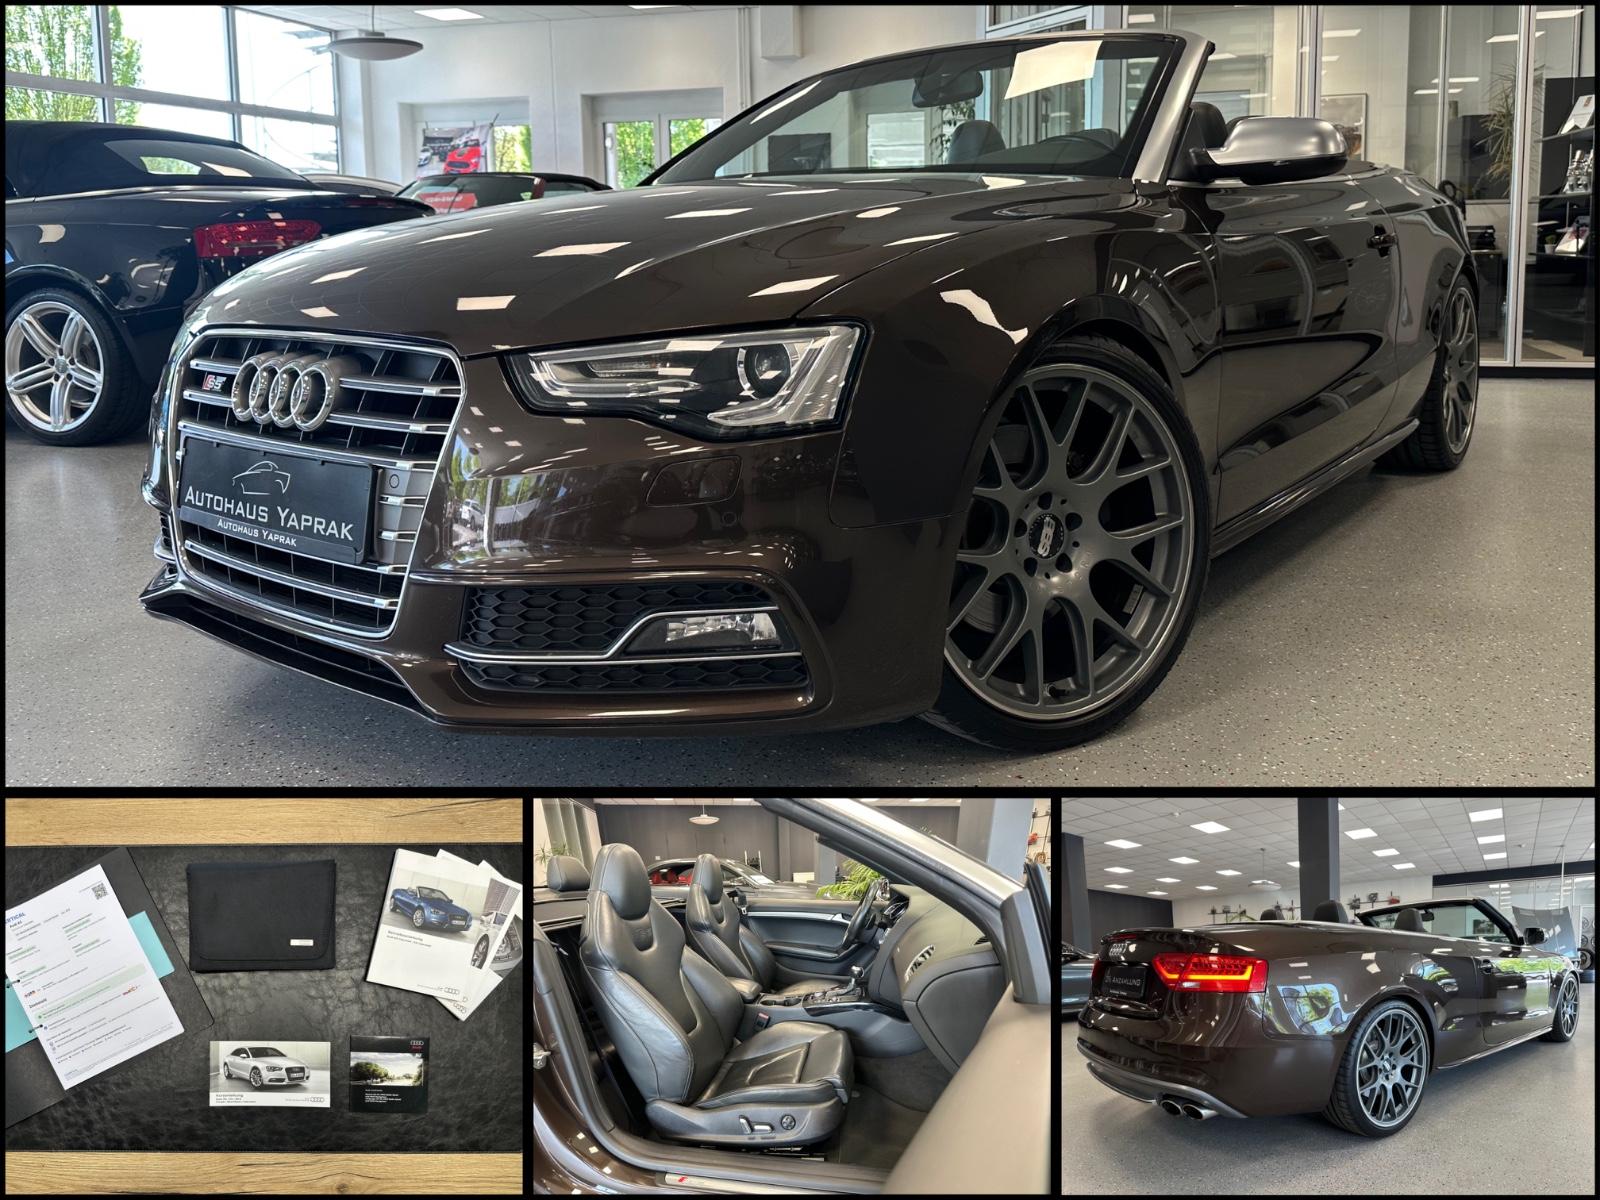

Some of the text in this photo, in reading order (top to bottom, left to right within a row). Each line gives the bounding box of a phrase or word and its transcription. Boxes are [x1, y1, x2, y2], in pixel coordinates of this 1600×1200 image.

[203, 374, 227, 390] S5
[184, 485, 354, 541] AUTOHAUS YAPRAK
[217, 519, 297, 547] AUTOHAUS YAPRAK
[1037, 516, 1056, 557] BBS
